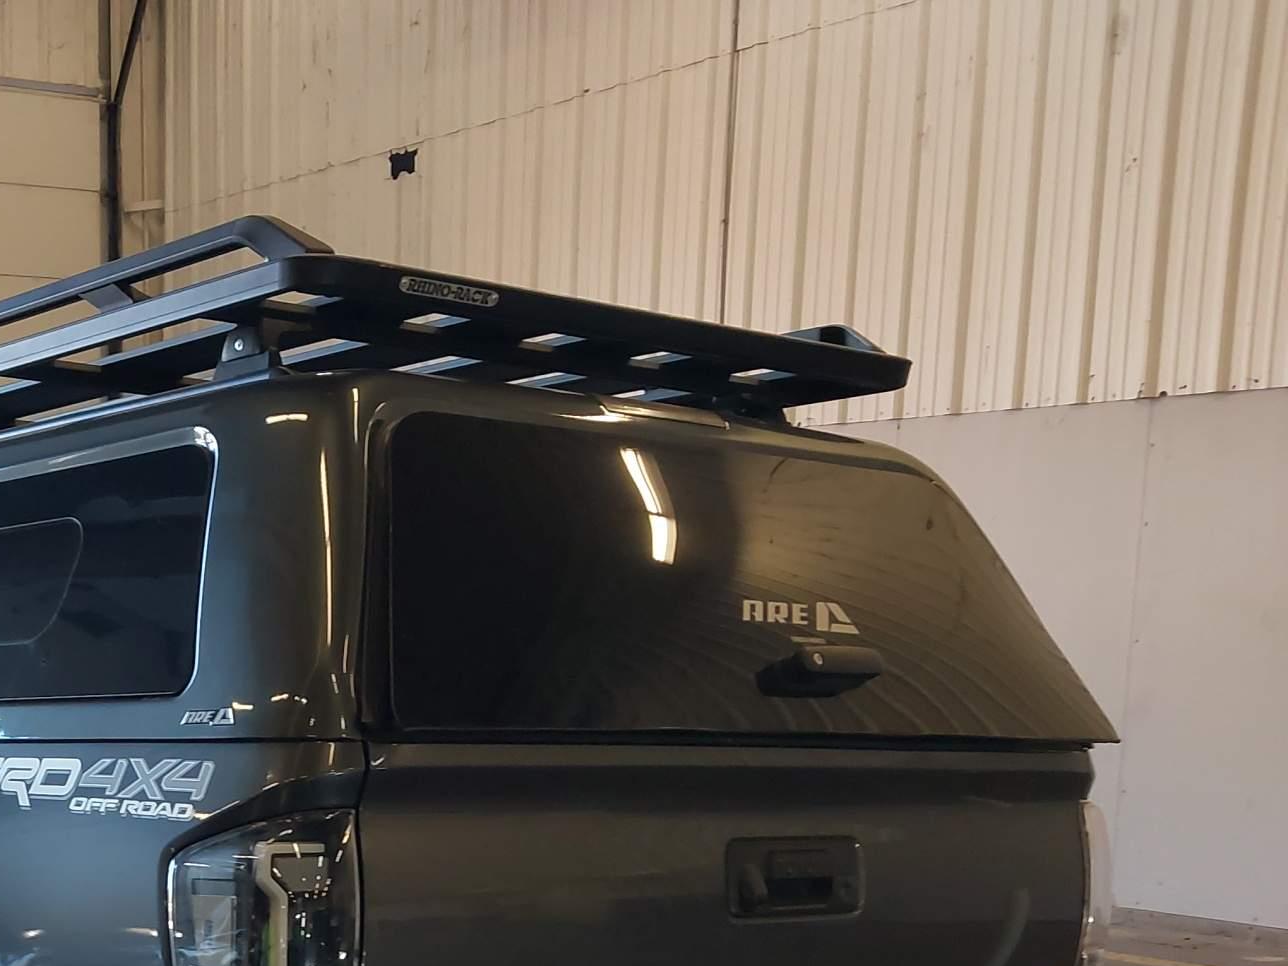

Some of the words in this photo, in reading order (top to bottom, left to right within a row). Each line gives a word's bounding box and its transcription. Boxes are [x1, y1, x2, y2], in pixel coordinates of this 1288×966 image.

[406, 278, 492, 305] RHINO-RACK
[68, 796, 119, 815] OFF
[119, 799, 195, 822] ROAD
